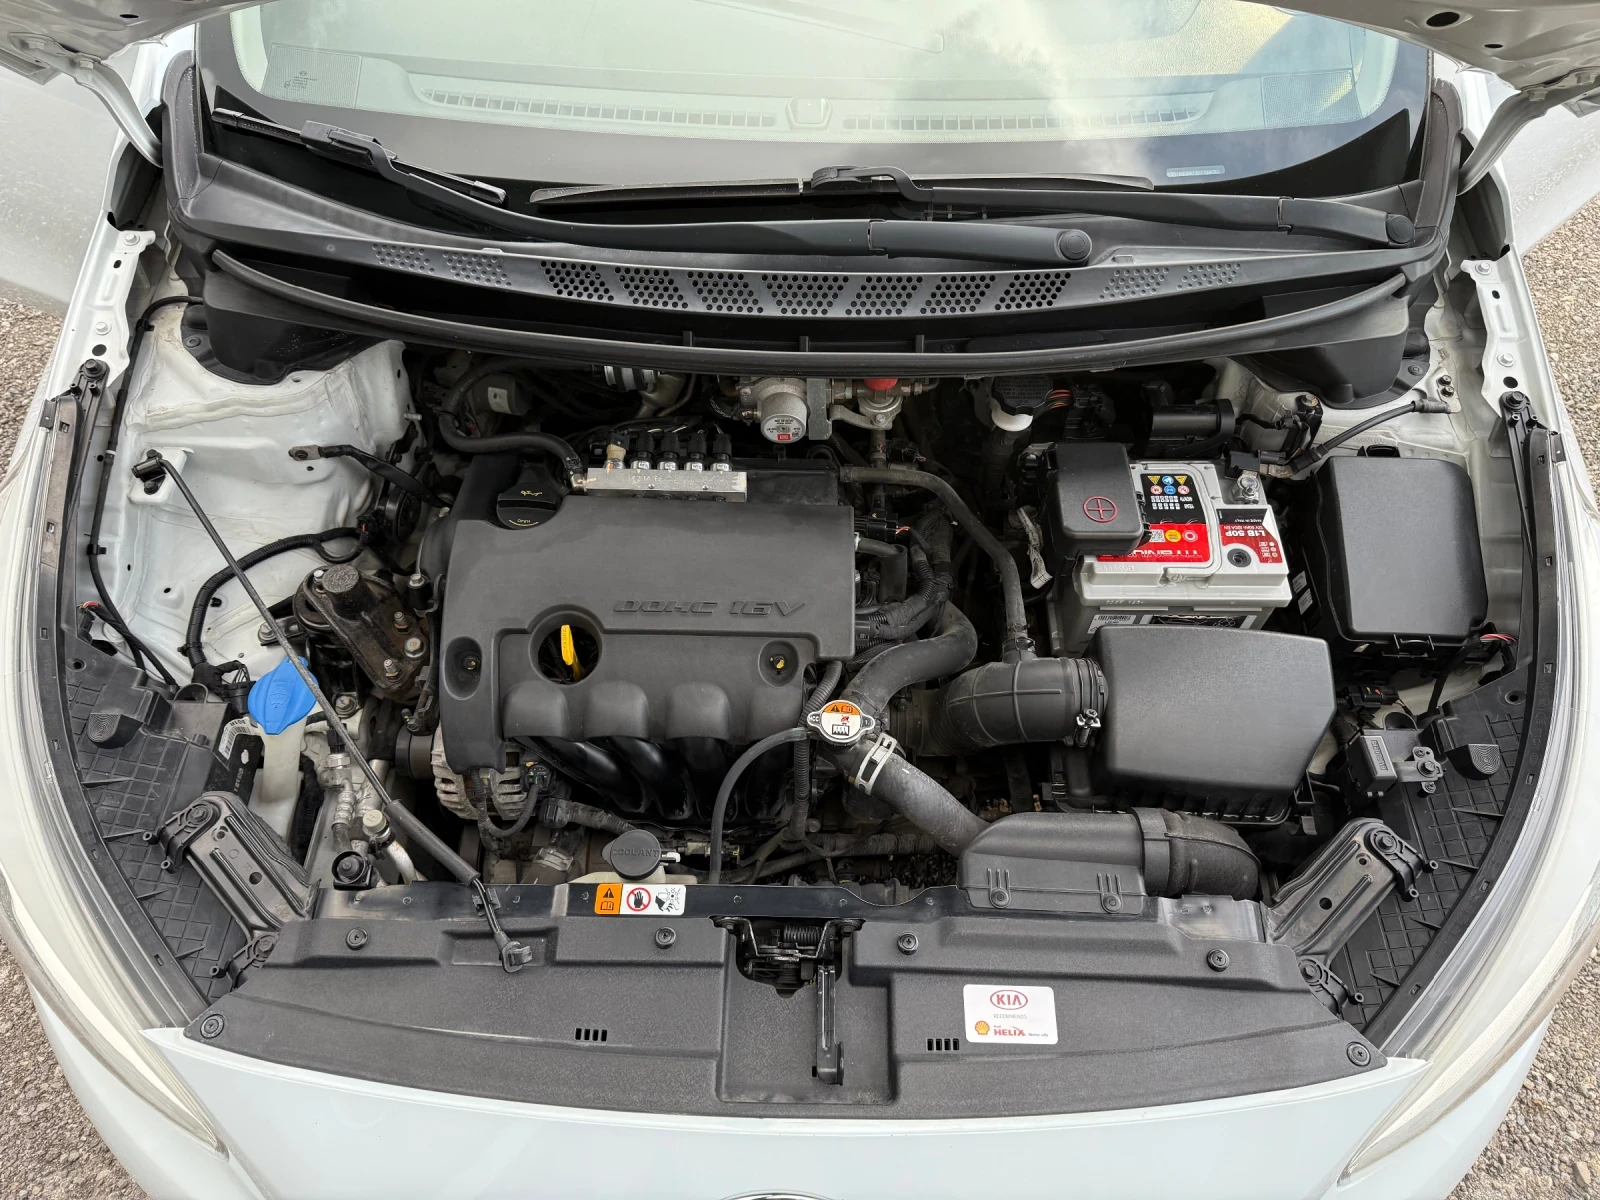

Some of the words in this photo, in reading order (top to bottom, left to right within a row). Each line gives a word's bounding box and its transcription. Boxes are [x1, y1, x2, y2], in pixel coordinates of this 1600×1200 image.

[613, 600, 719, 613] DOHC
[729, 601, 807, 616] 16V
[611, 848, 660, 858] COOLANT
[996, 994, 1022, 1006] KIA
[993, 1028, 1026, 1036] HELIX
